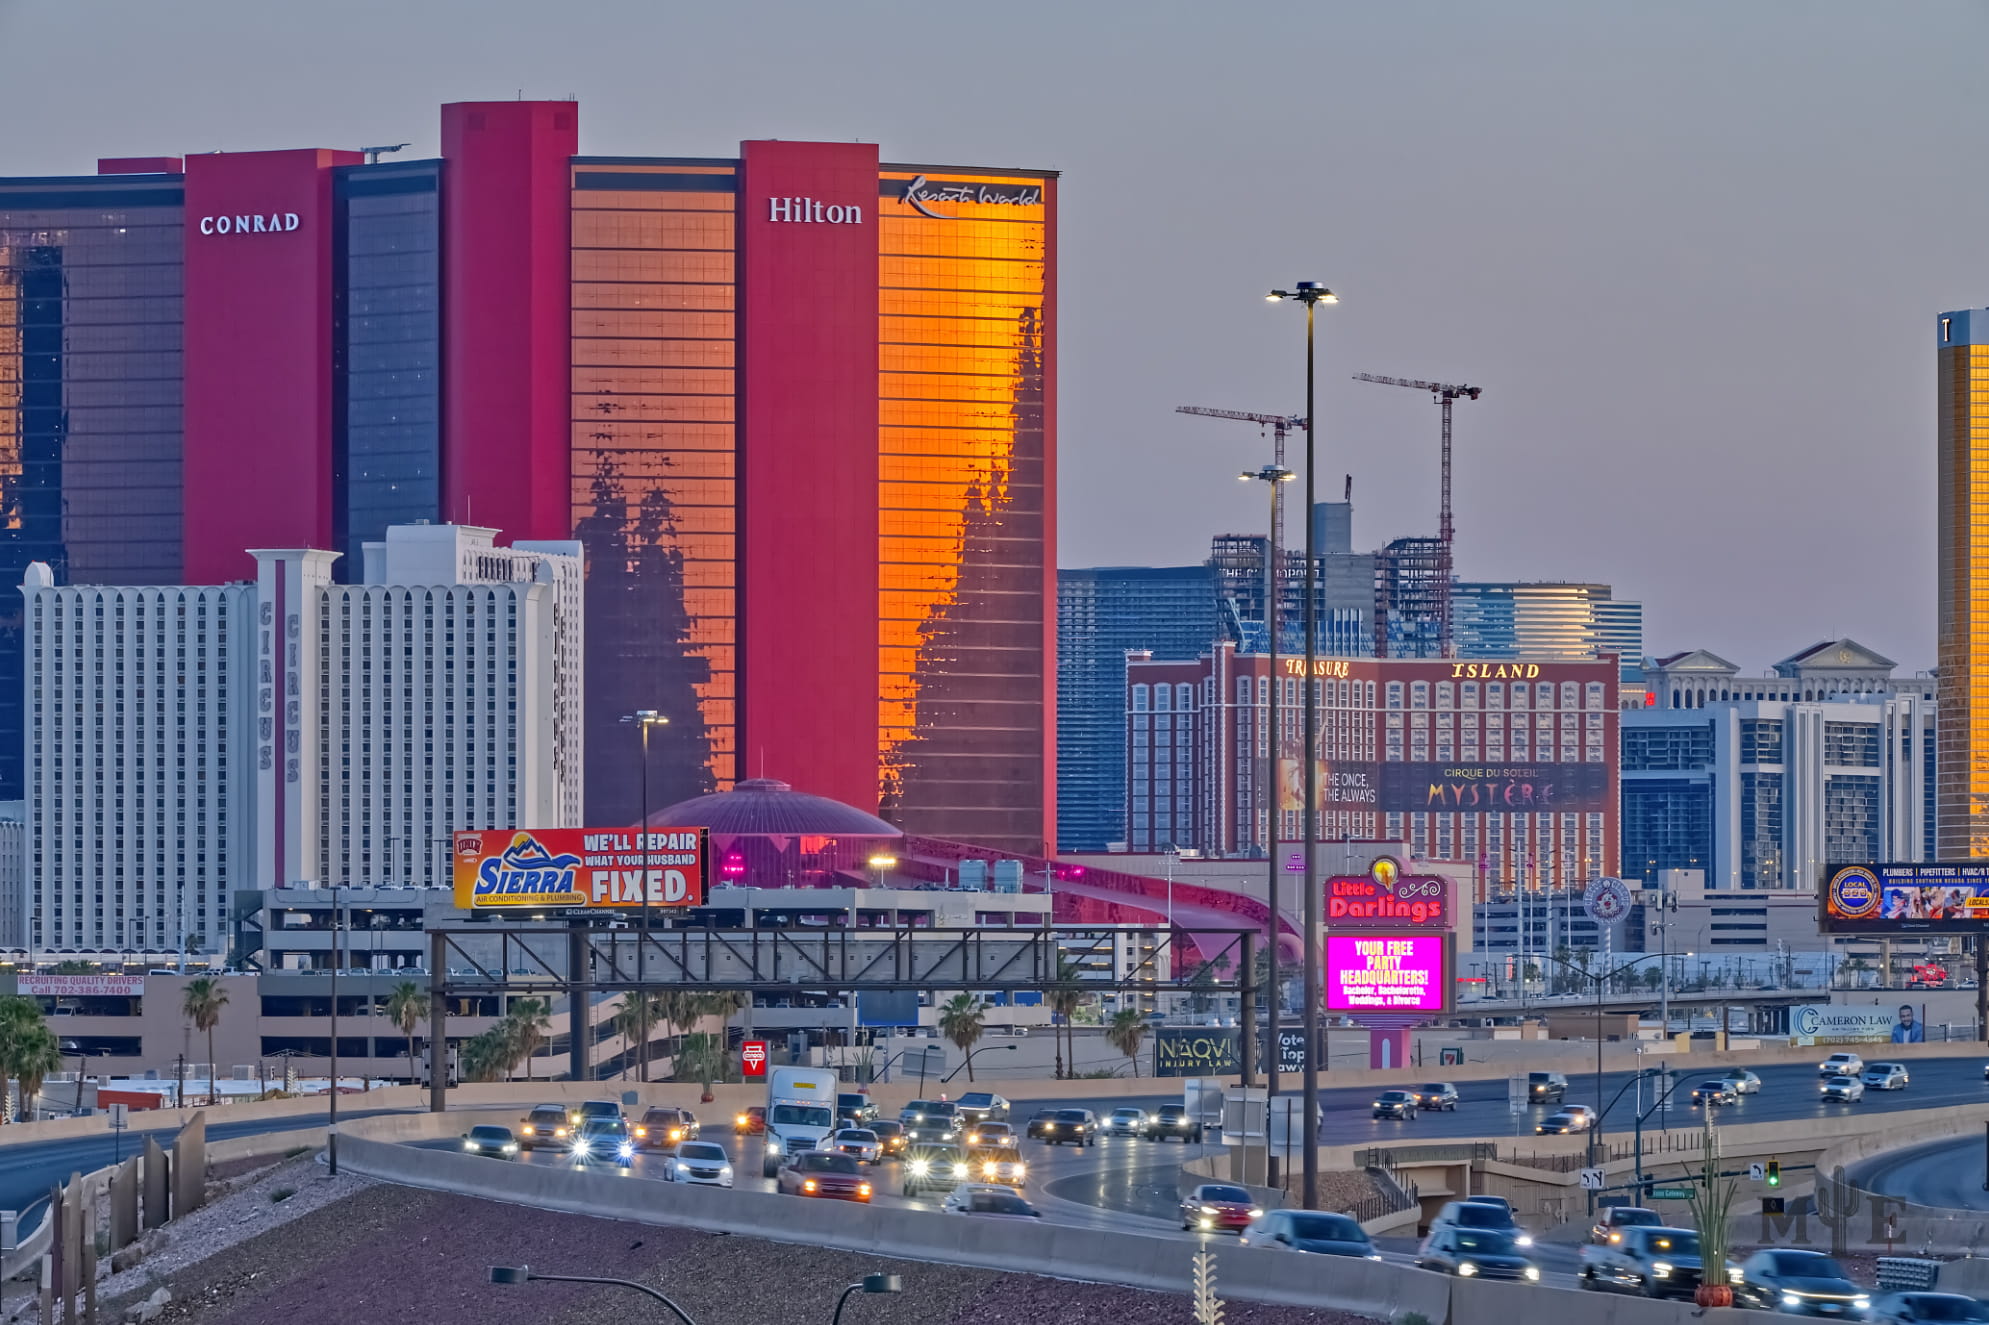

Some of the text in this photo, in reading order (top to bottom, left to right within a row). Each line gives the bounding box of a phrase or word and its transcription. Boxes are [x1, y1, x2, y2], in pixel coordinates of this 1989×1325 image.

[769, 197, 862, 224] Hilton
[200, 213, 299, 235] CONRAD
[1451, 663, 1540, 678] ISLAND
[259, 602, 272, 770] CIRCUS
[287, 614, 300, 783] CIRCUS
[1323, 773, 1369, 789] THE ONCE,
[1444, 768, 1538, 780] CIRQUE DU SOLEIL
[1324, 788, 1376, 803] THE ALWAYS
[636, 833, 696, 850] REPAIR
[585, 854, 696, 866] WHAT YOUR HUSBAND
[475, 858, 574, 894] SIERRA
[1883, 868, 1913, 876] PLUMBERS
[1920, 868, 1956, 876] PIPEFITTERS
[592, 870, 693, 902] FIXED.
[1333, 882, 1375, 896] Little
[1329, 894, 1441, 922] Darlings
[1355, 941, 1414, 956] YOUR FREE
[1366, 956, 1401, 970] PARTY
[19, 976, 143, 985] RECRUITING QUALITY DRIVERS
[1340, 970, 1428, 985] HEADQUARTERS!
[31, 986, 131, 994] Call 702-386-7400
[1811, 1015, 1892, 1026] CAMERON LAW
[1160, 1038, 1231, 1060] NAQVI
